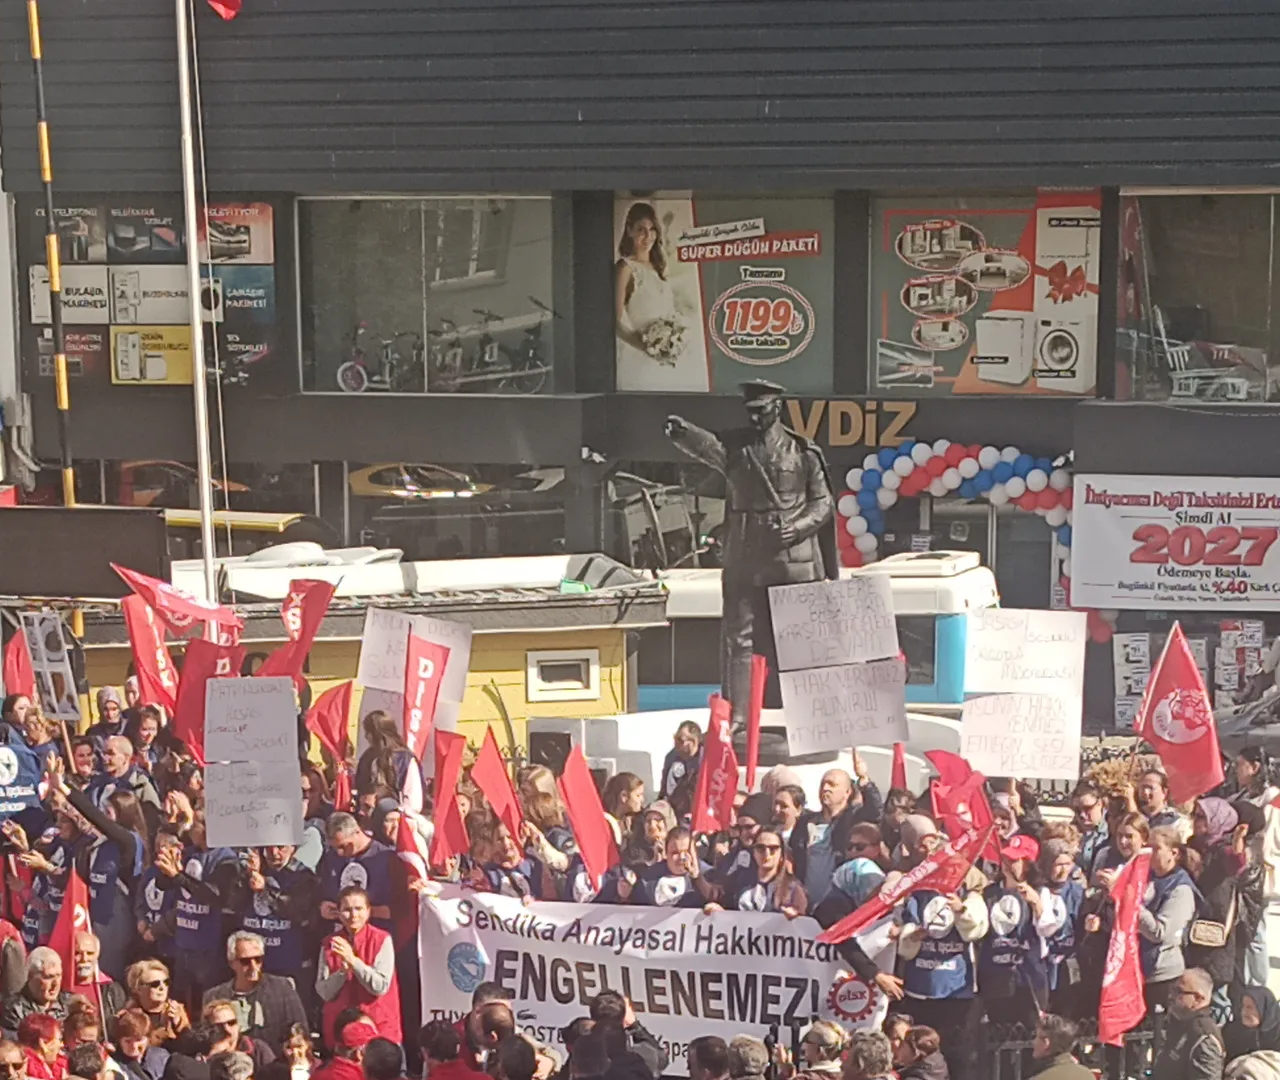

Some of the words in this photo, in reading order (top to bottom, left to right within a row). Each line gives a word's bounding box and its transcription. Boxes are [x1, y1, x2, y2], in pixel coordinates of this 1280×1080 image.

[724, 239, 769, 256] DÜĞÜN
[773, 233, 818, 252] PAKETİ
[1175, 510, 1214, 525] Şimdi
[1157, 565, 1211, 580] Ödemeye
[1212, 580, 1248, 594] %40
[456, 898, 556, 942] Sendika
[561, 917, 686, 954] Anayasal
[494, 949, 819, 1026] ENGELLENEMEZ!
